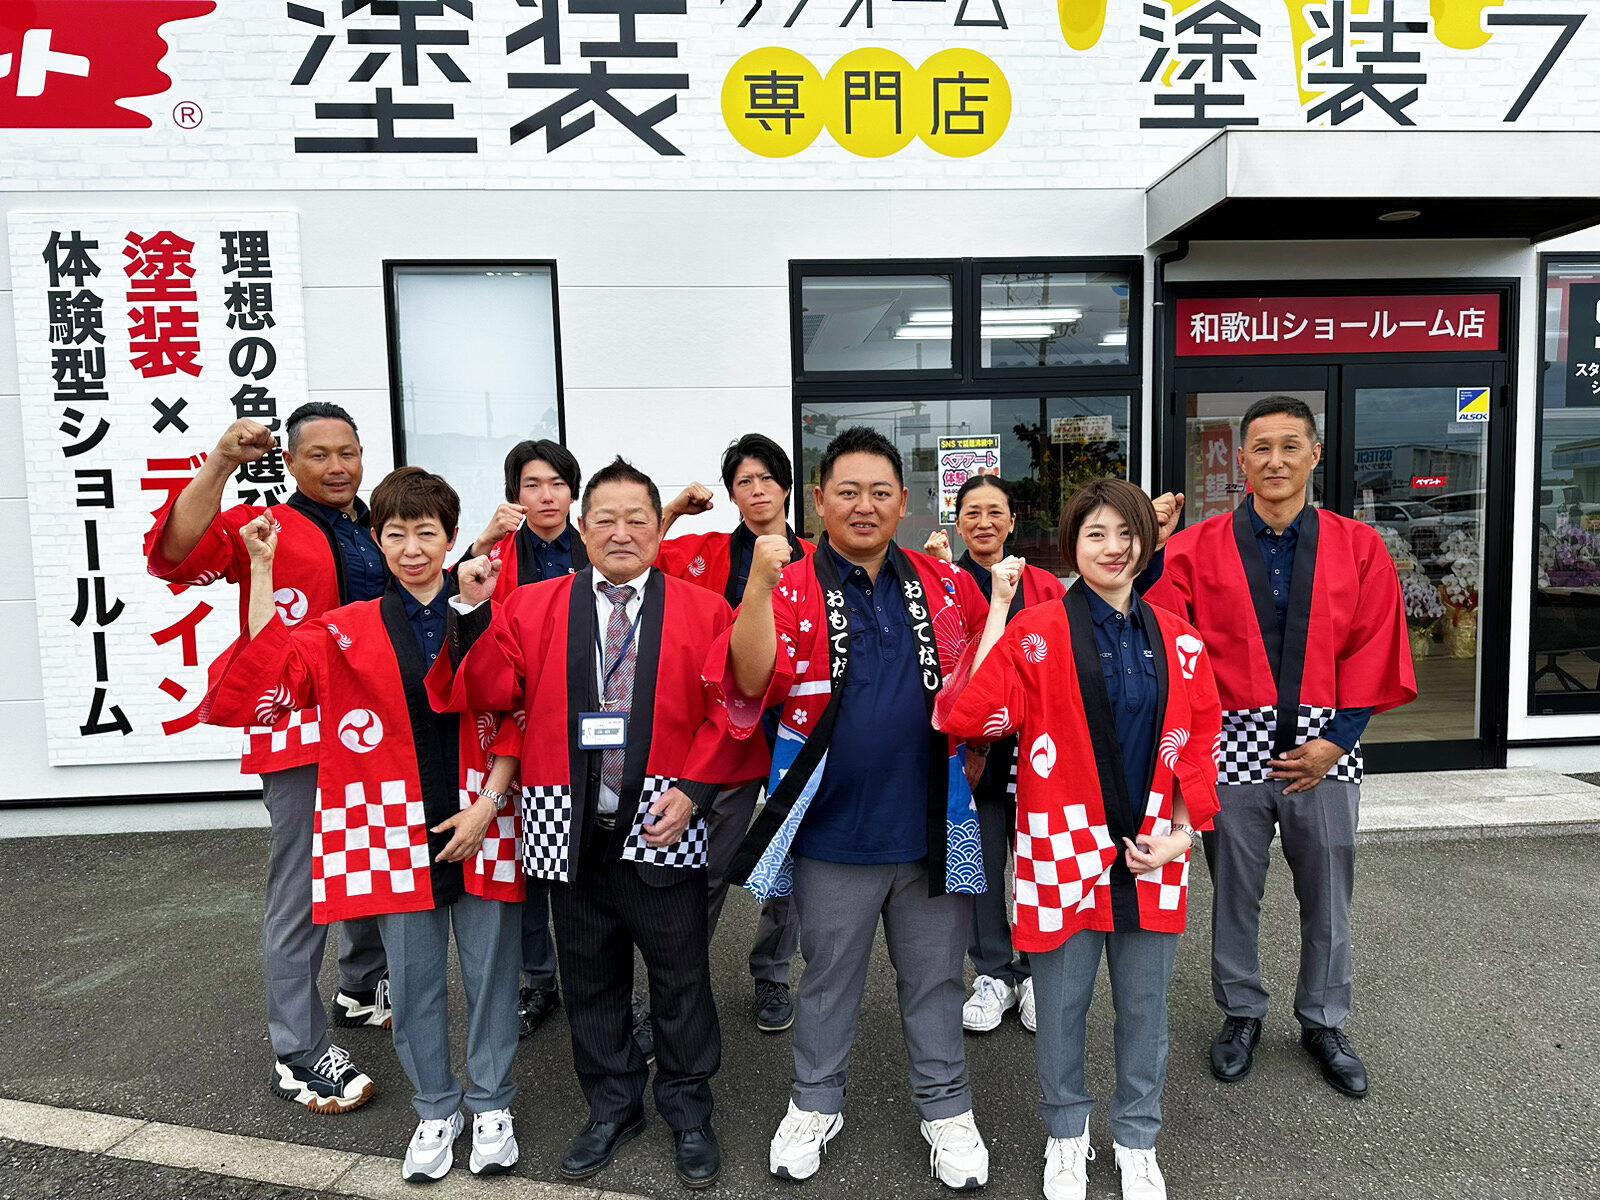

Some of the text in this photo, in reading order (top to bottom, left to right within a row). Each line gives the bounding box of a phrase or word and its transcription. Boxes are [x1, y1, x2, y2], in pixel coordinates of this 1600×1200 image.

[287, 0, 689, 156] 塗装
[744, 70, 989, 135] 専門店
[1190, 308, 1486, 344] 和歌山ショールーム店
[42, 230, 133, 736] 体験型ショールーム
[903, 580, 940, 690] おもてなし
